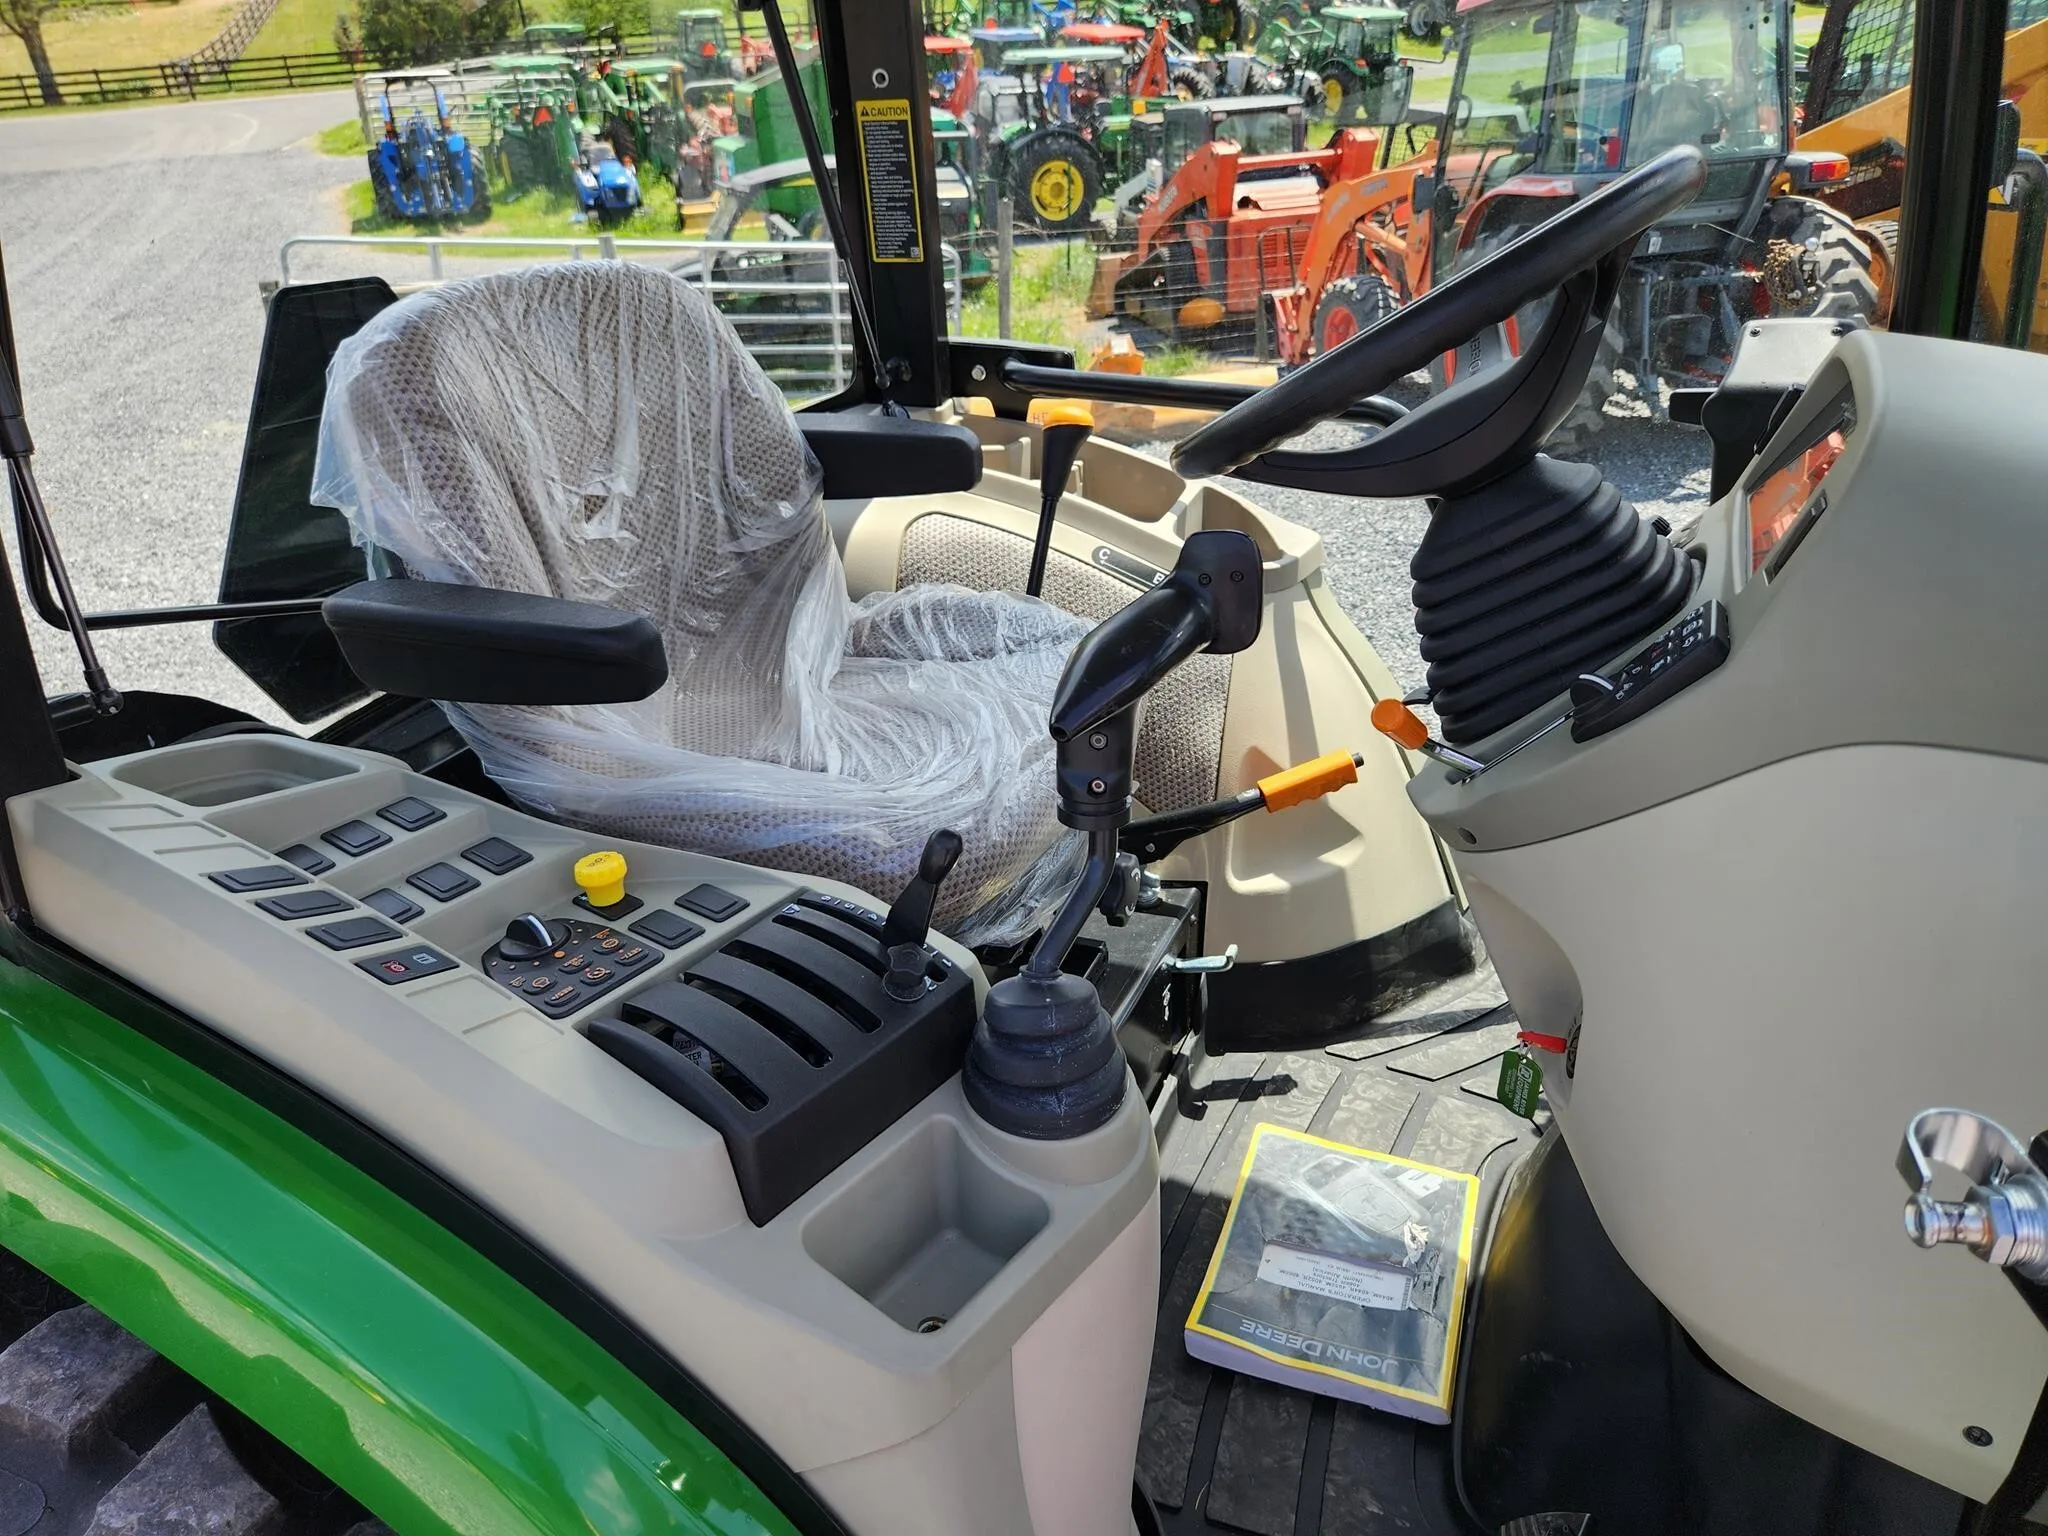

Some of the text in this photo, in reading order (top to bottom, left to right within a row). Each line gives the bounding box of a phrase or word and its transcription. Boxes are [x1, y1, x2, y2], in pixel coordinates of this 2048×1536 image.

[870, 106, 909, 117] CAUTION
[1099, 548, 1111, 560] C
[844, 902, 855, 910] 5
[1313, 1266, 1341, 1279] America)
[1343, 1274, 1363, 1284] (North
[1297, 1280, 1371, 1303] OPERATOR'S MANUAL
[1239, 1318, 1399, 1374] JOHN DEERE
